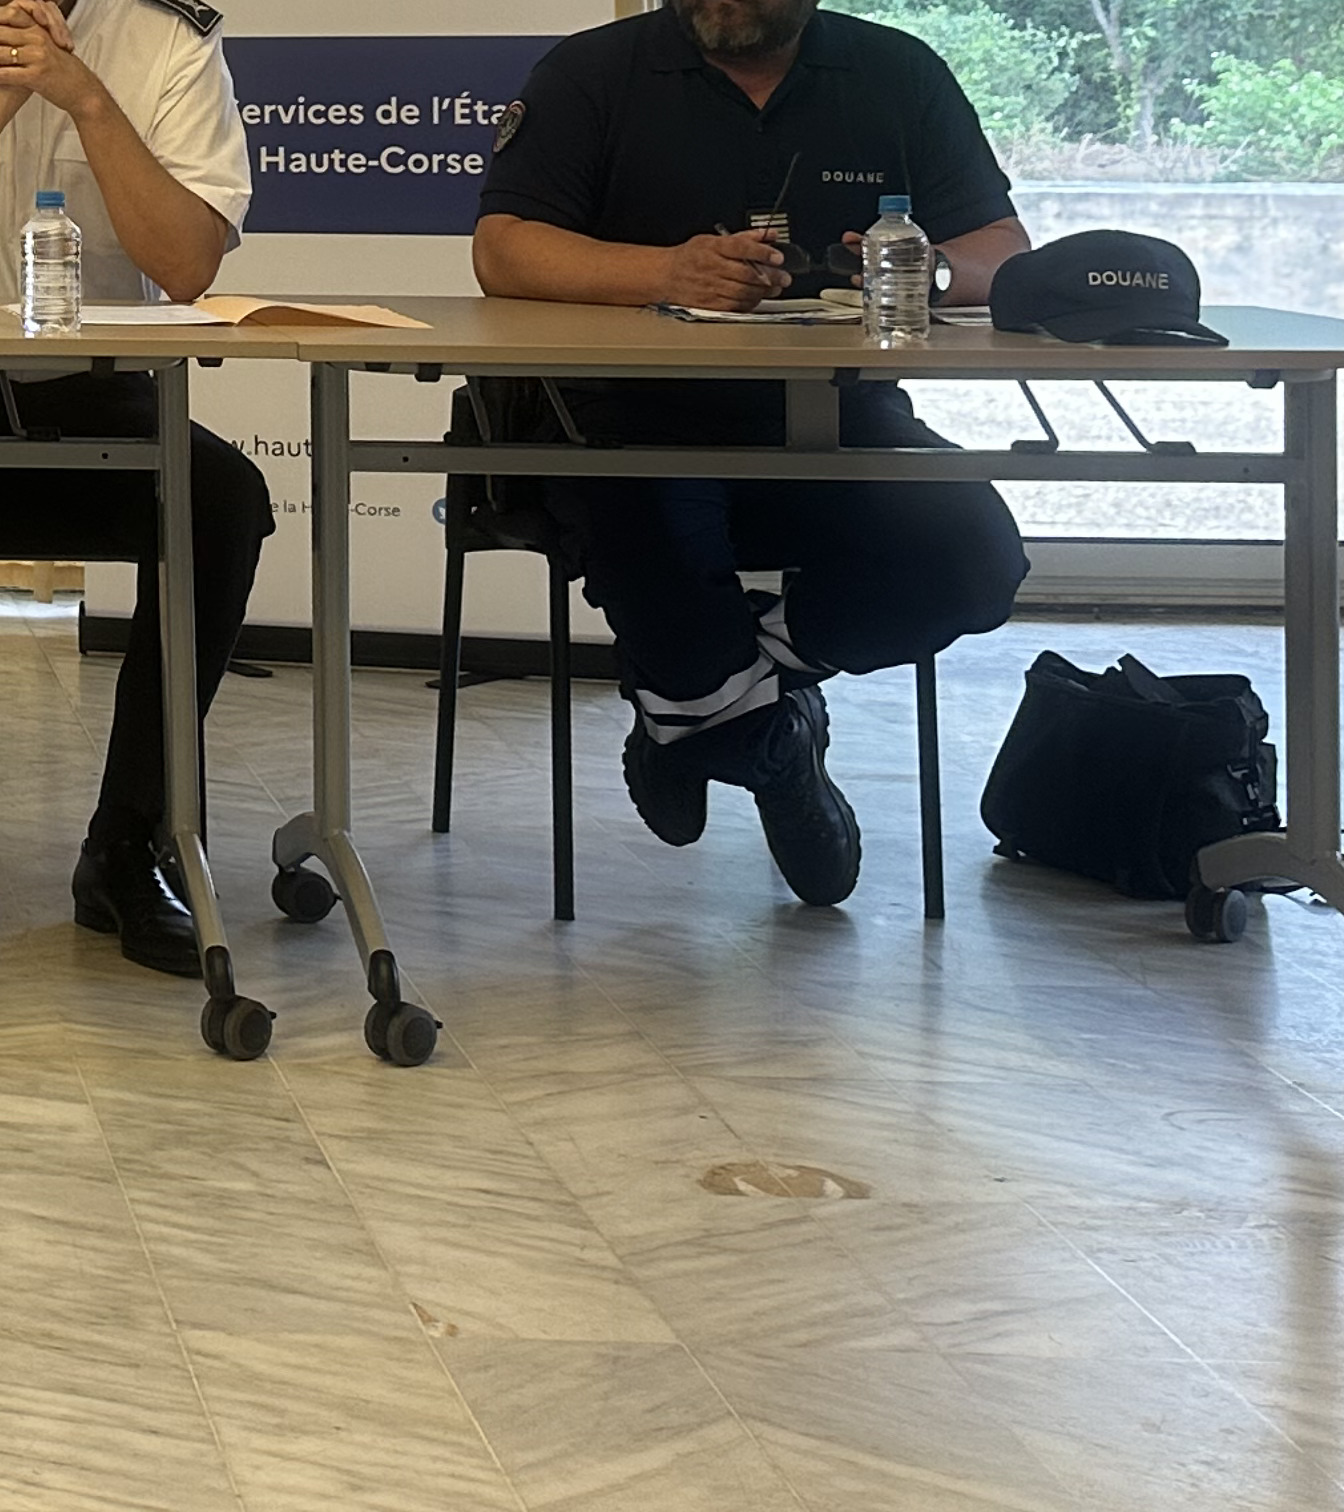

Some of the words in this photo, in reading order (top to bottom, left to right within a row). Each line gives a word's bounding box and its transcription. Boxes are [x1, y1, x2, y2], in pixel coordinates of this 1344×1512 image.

[236, 95, 365, 126] ervices
[375, 95, 421, 126] de
[432, 90, 508, 126] l'Éta
[259, 145, 485, 175] Haute-Corse
[821, 170, 885, 184] DOUANE
[1087, 269, 1169, 290] DOUANE
[283, 498, 297, 514] la
